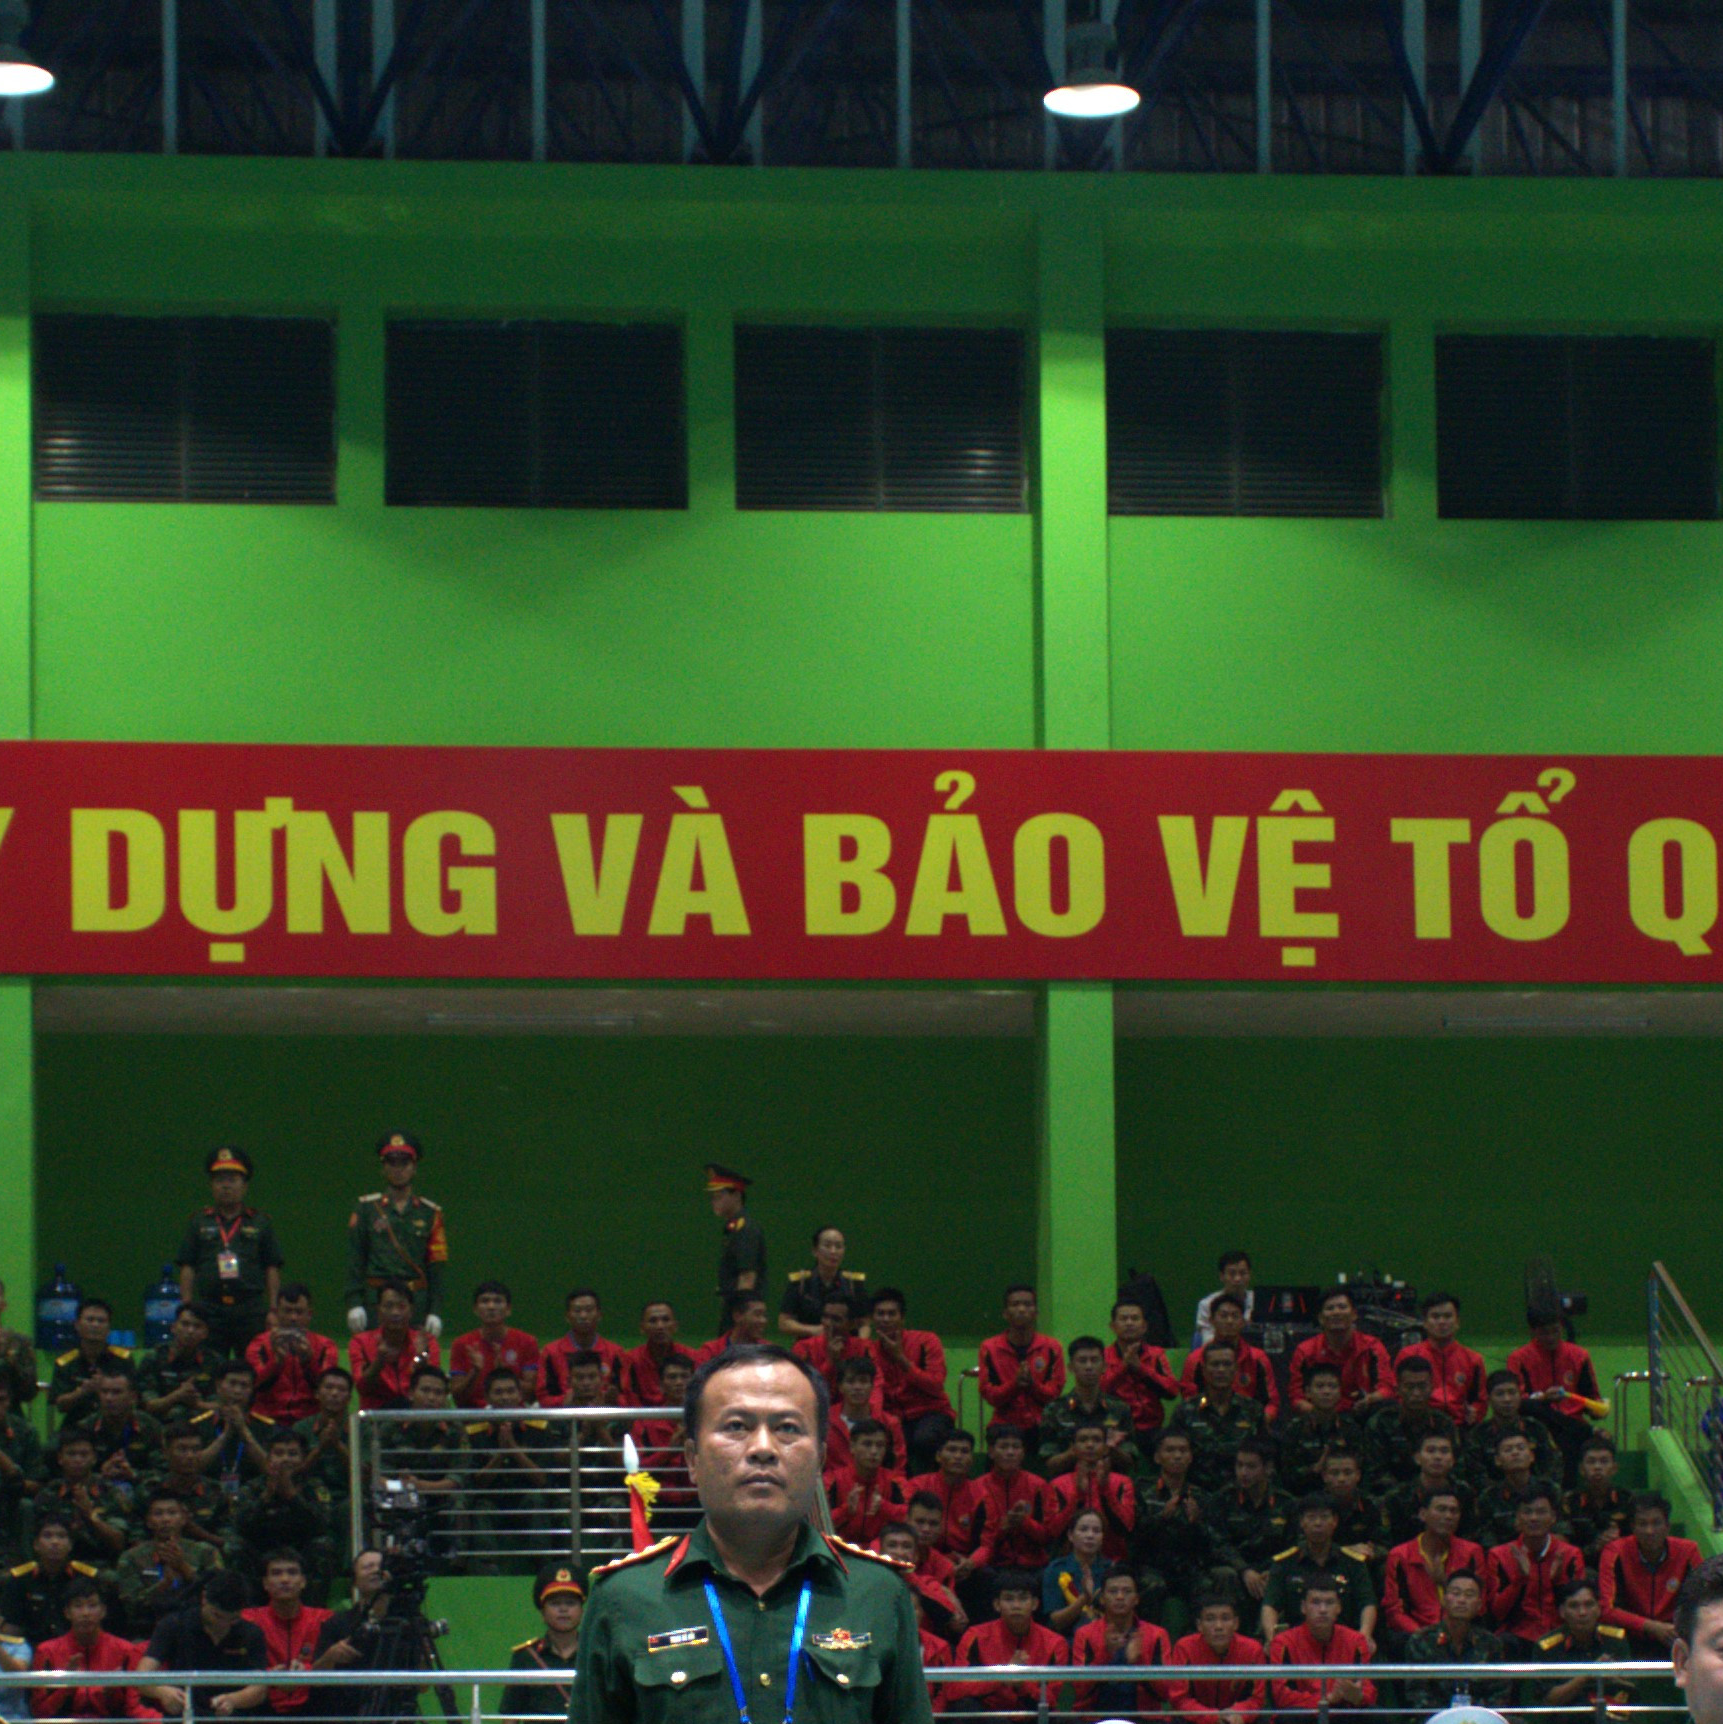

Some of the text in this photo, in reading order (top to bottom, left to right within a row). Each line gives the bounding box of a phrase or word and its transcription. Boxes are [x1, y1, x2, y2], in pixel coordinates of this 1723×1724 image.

[70, 796, 497, 963] DỰNG
[549, 784, 752, 936] VÀ
[802, 770, 1106, 936] BẢO
[1159, 789, 1339, 966] VỆ
[1390, 766, 1573, 942] TỔ
